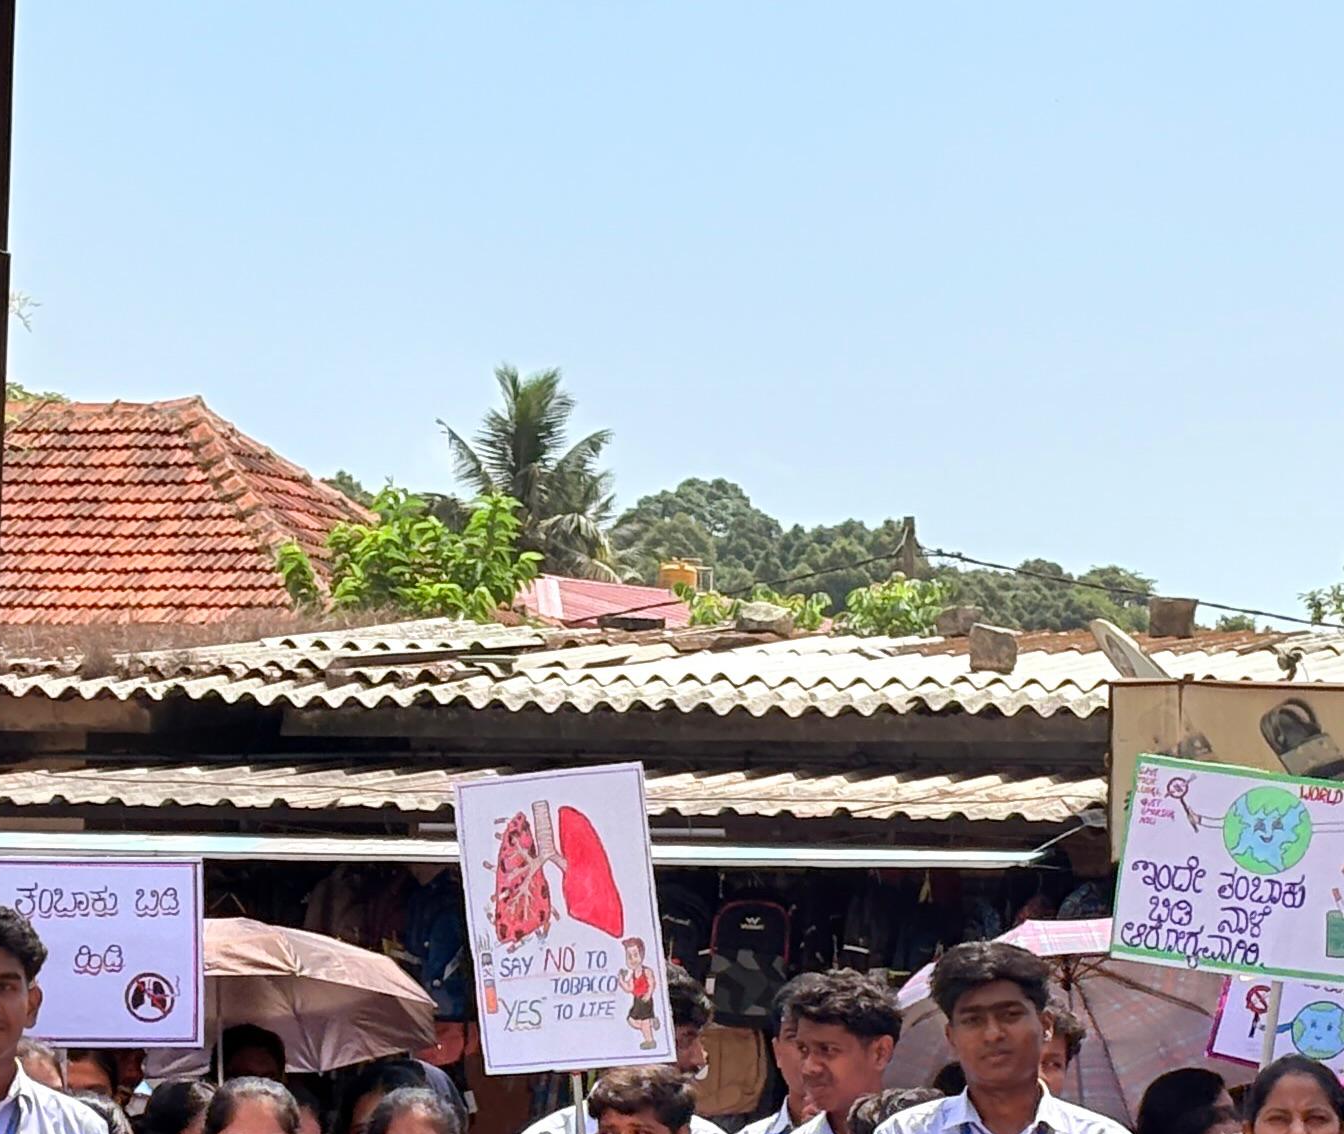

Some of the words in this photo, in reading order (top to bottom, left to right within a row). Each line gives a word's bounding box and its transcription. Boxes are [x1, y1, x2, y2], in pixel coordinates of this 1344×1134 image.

[1299, 784, 1344, 805] WORLD
[15, 882, 118, 919] ತಂಬಾಕು
[135, 887, 180, 917] ಬಿಡಿ
[499, 955, 534, 978] SAY
[586, 950, 608, 969] TO
[550, 975, 619, 996] TOBACCO
[553, 1003, 574, 1020] TO
[579, 1000, 616, 1018] LIFE
